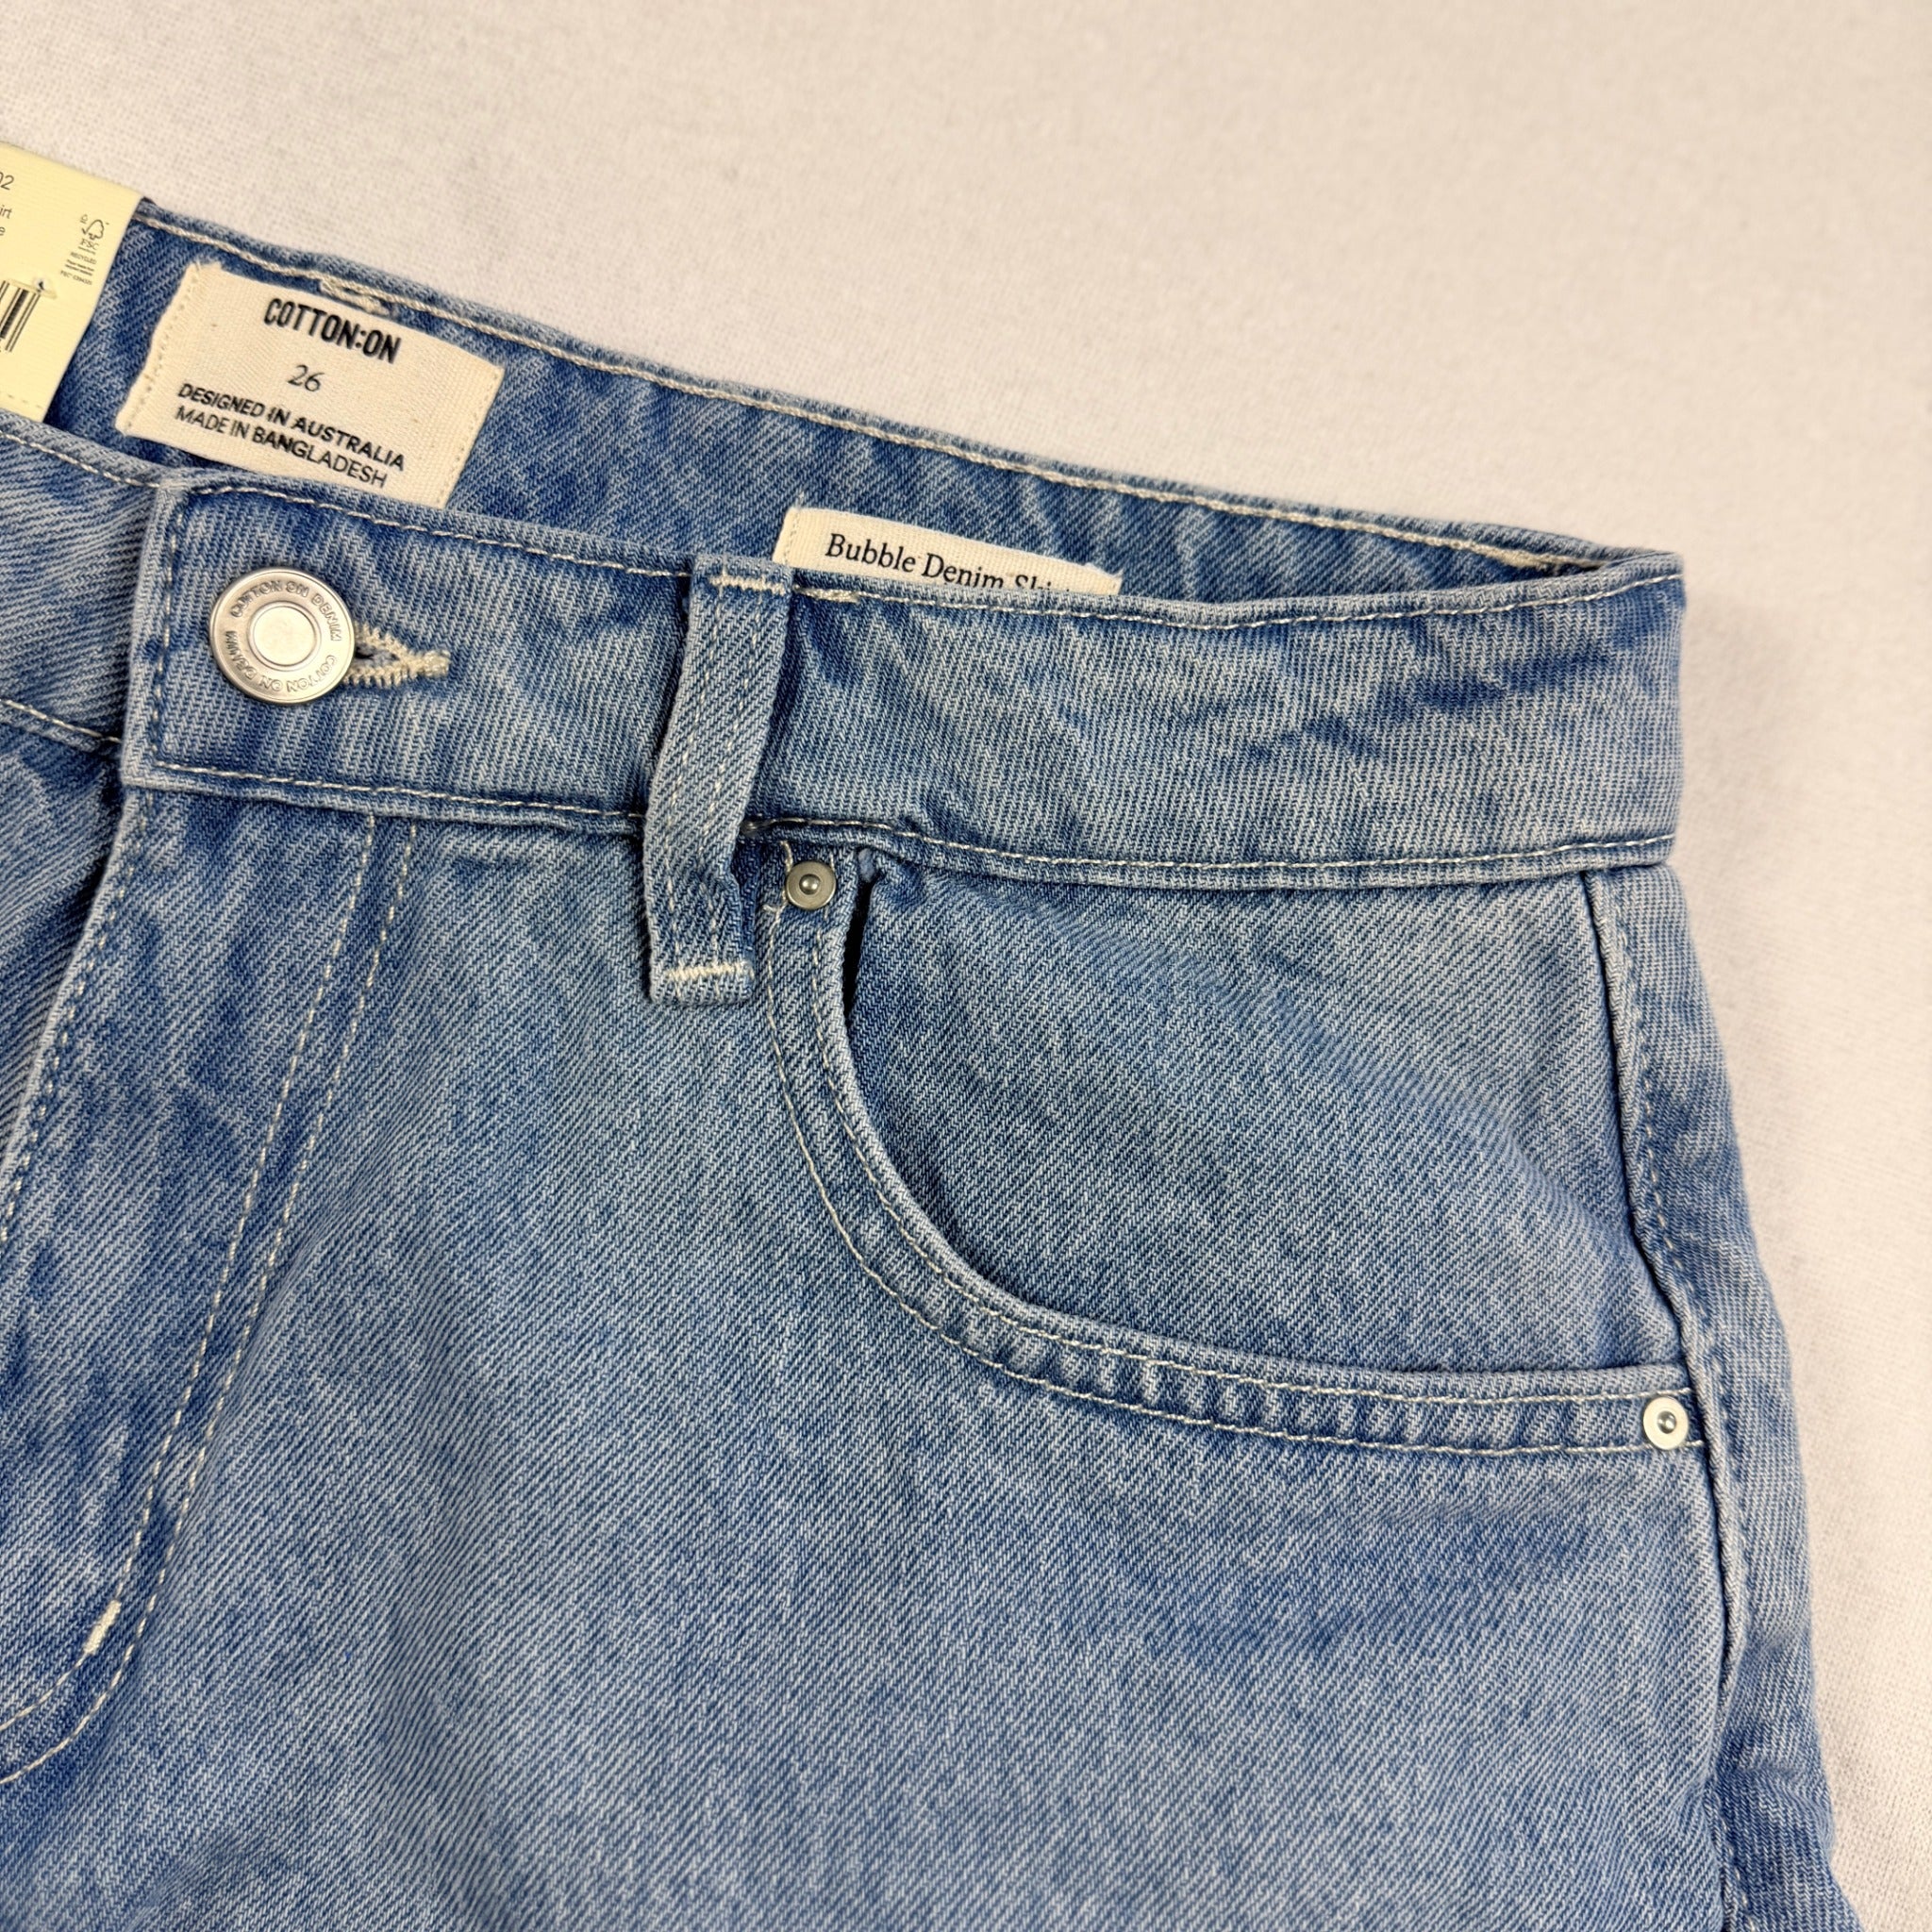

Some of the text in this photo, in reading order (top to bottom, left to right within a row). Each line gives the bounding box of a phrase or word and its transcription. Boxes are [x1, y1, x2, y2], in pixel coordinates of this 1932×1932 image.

[80, 238, 99, 250] FSC
[263, 298, 402, 364] COTTON:ON
[287, 364, 325, 392] 26
[175, 405, 388, 490] MADE IN BANGLADESH
[177, 382, 405, 472] DESIGNED IN AUSTRALIA
[824, 532, 916, 574] Bubble
[921, 553, 1005, 589] Denim
[231, 580, 343, 642] COTTON ON DENIM
[258, 675, 284, 692] ON
[286, 654, 338, 693] COTTON
